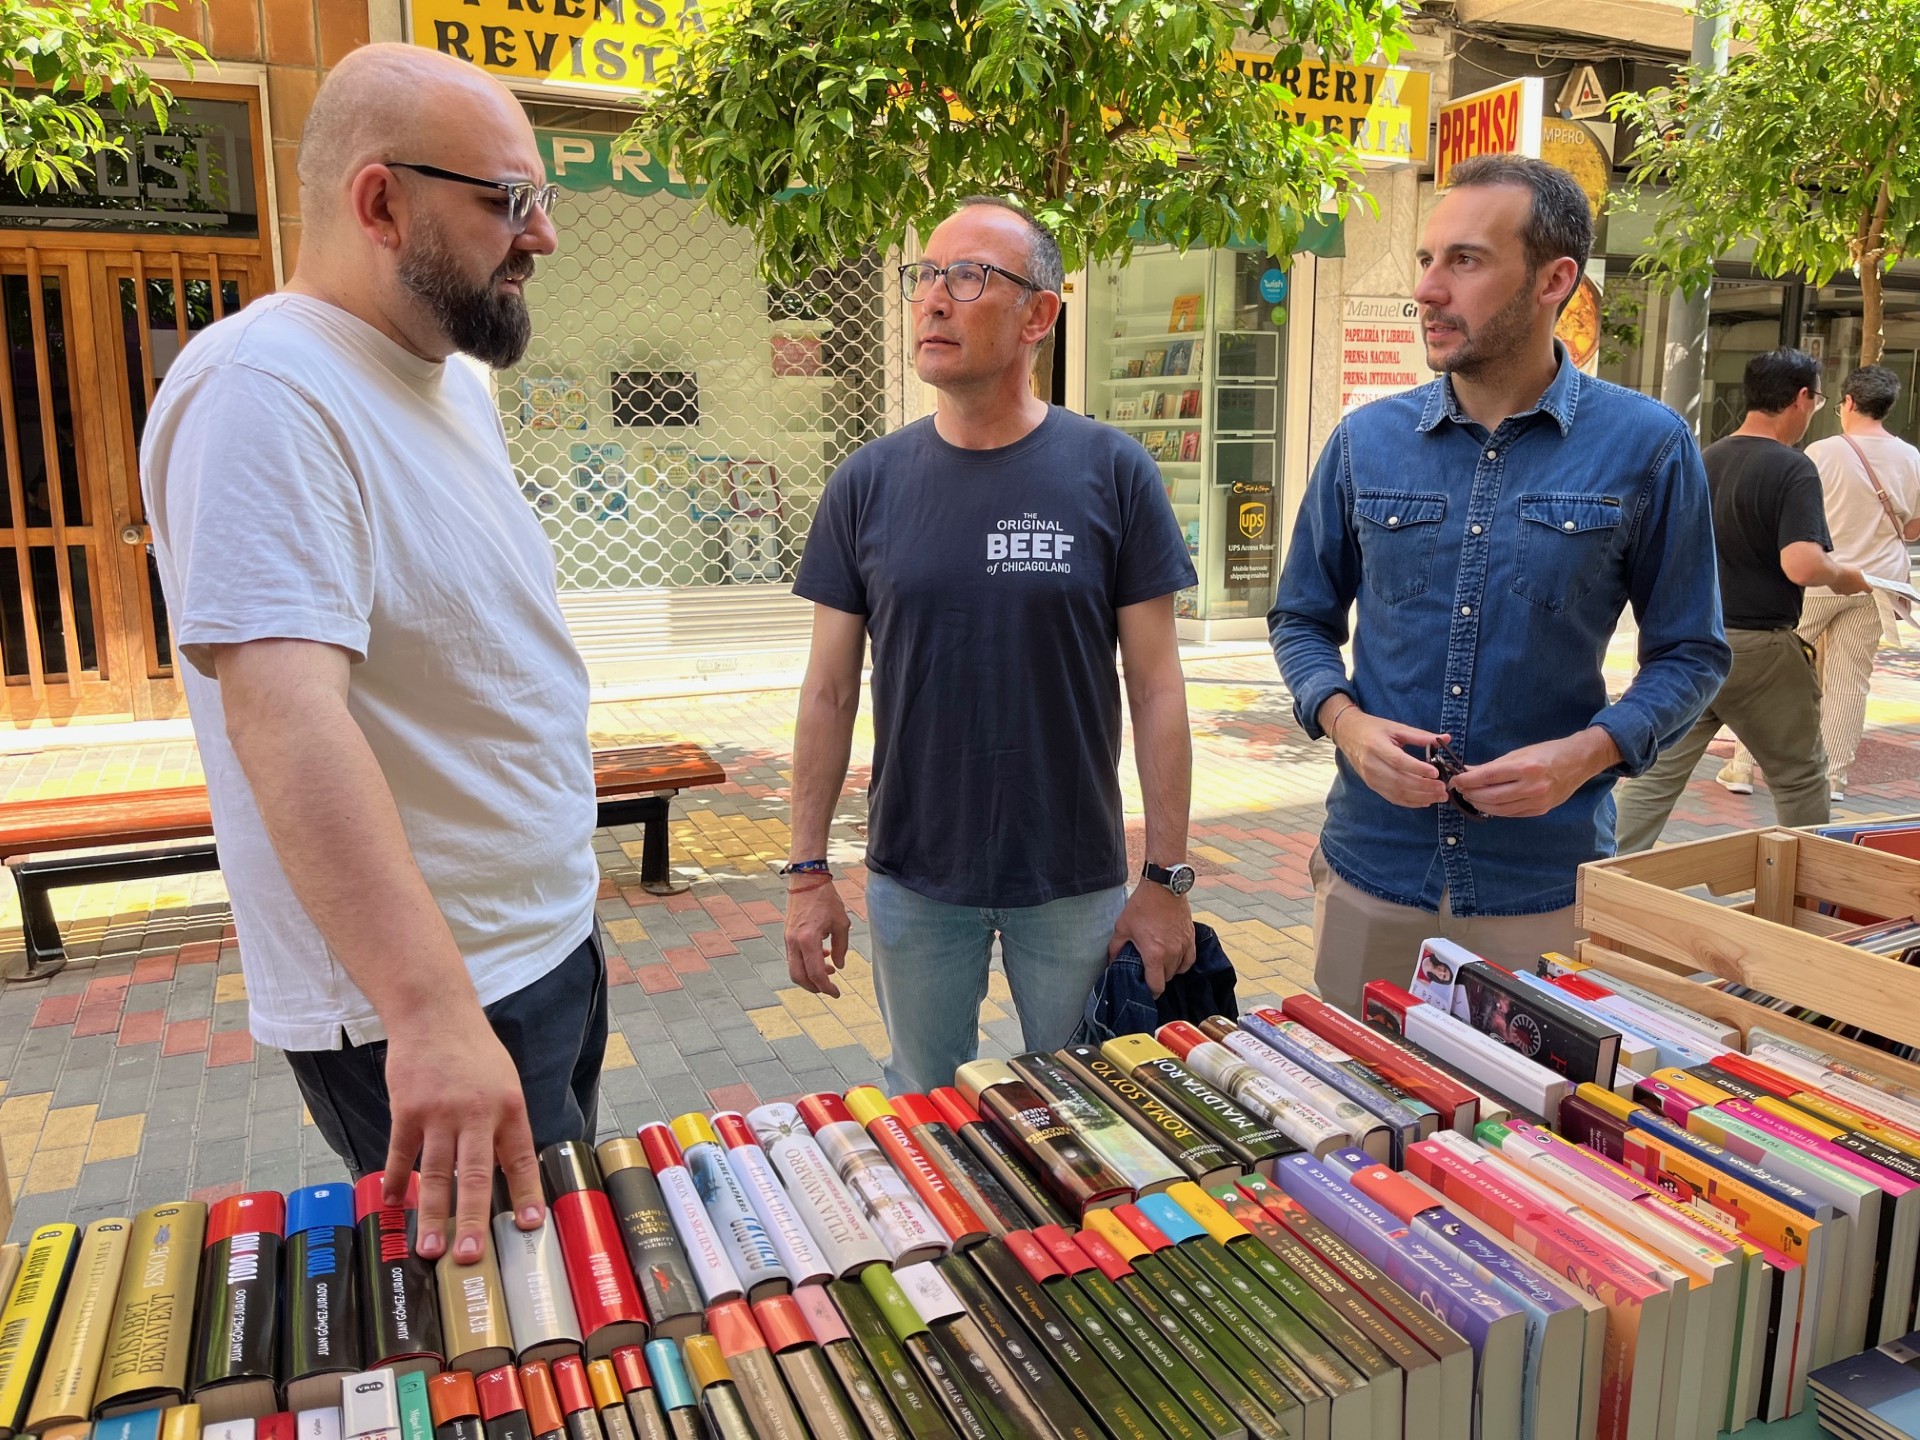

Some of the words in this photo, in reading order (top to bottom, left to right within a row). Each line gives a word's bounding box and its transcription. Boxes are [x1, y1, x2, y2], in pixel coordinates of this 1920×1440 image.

[463, 0, 708, 33] NSA
[1222, 59, 1400, 109] IBRERIA
[1438, 90, 1518, 185] PRENSA
[1347, 301, 1400, 317] Manuel
[1345, 325, 1379, 342] PAPELERÍA
[1381, 330, 1385, 342] Y
[1386, 326, 1415, 343] LIBRERÍA
[1344, 350, 1368, 363] PRENSA
[1370, 351, 1400, 364] NACIONAL
[1343, 372, 1367, 385] PRENSA
[1369, 372, 1418, 385] INTERNACIONAL
[997, 520, 1064, 531] ORIGINAL
[1241, 513, 1264, 532] ups
[987, 533, 1074, 560] BEEF
[987, 562, 999, 575] of
[1002, 561, 1071, 574] CHICAGOLAND
[1090, 1061, 1116, 1078] YO
[1109, 1078, 1147, 1101] SOY
[1182, 1077, 1255, 1129] MALDITA
[1143, 1100, 1194, 1140] ROMA
[713, 1153, 728, 1176] CARME
[724, 1176, 749, 1213] CHAPARRO
[785, 1148, 830, 1206] NAVARRO
[911, 1156, 945, 1193] LLUVIA
[1308, 1168, 1342, 1193] GRACE
[1441, 1157, 1477, 1179] GRACE
[1341, 1192, 1387, 1225] HANNAH
[1477, 1178, 1524, 1209] HANNAH
[750, 1166, 767, 1182] EL
[771, 1203, 791, 1228] DEL
[784, 1228, 813, 1263] LOBO
[820, 1208, 854, 1244] JULIA
[380, 1233, 410, 1263] TODO
[689, 1219, 720, 1268] SIGUIENTES
[1312, 1237, 1340, 1263] EVELYN
[1338, 1260, 1365, 1281] HUGO
[1321, 1234, 1345, 1256] SIETE
[1343, 1253, 1378, 1281] MARIDOS
[228, 1254, 259, 1285] TODO
[307, 1247, 336, 1279] TODO
[588, 1251, 615, 1276] ROJA
[1281, 1250, 1310, 1274] EVELYN
[1307, 1270, 1333, 1293] HUGO
[1290, 1245, 1315, 1268] SIETE
[1312, 1262, 1348, 1294] MARIDOS
[314, 1282, 330, 1337] GÓMEZ-JURADO
[392, 1267, 407, 1322] GÓMEZ-JURADO
[462, 1276, 489, 1314] BLANCO
[596, 1277, 623, 1307] REINA
[1251, 1295, 1279, 1320] DICKER
[1470, 1286, 1502, 1308] En
[229, 1288, 247, 1341] GÓMEZ-JURADO
[398, 1323, 409, 1340] JUAN
[468, 1313, 494, 1334] REY
[1280, 1277, 1302, 1297] MOLA
[1343, 1334, 1380, 1369] ALFAGUARA
[1345, 1299, 1370, 1319] TAYLOR
[1366, 1317, 1396, 1343] JENKINS
[1393, 1340, 1413, 1358] REID
[1399, 1305, 1427, 1330] JENKINS
[1425, 1326, 1445, 1343] REID
[112, 1300, 150, 1381] ELÍSABET
[139, 1293, 176, 1375] BENAVENT
[230, 1341, 242, 1362] JUAN
[318, 1338, 330, 1356] JUAN
[1214, 1300, 1239, 1323] MILLÁS
[1240, 1323, 1270, 1353] ARSUAGA
[1275, 1358, 1311, 1394] ALFAGUARA
[1022, 1361, 1042, 1383] MOLA
[1188, 1308, 1215, 1334] URRACA
[1247, 1368, 1284, 1406] ALFAGUARA
[984, 1376, 1002, 1395] MOLA
[1061, 1341, 1082, 1363] MOLA
[1114, 1406, 1147, 1440] ALFAGUAR
[1134, 1327, 1149, 1344] DEL
[1146, 1341, 1174, 1368] MOLINO
[1191, 1389, 1228, 1428] ALFAGUARA
[1179, 1334, 1206, 1360] VICENT
[1240, 1399, 1277, 1437] ALFAGUARA
[906, 1391, 922, 1410] DÍAZ
[941, 1377, 963, 1404] MILLÁS
[959, 1405, 987, 1440] ARSUAGA
[1156, 1400, 1193, 1439] ALFAGUARA
